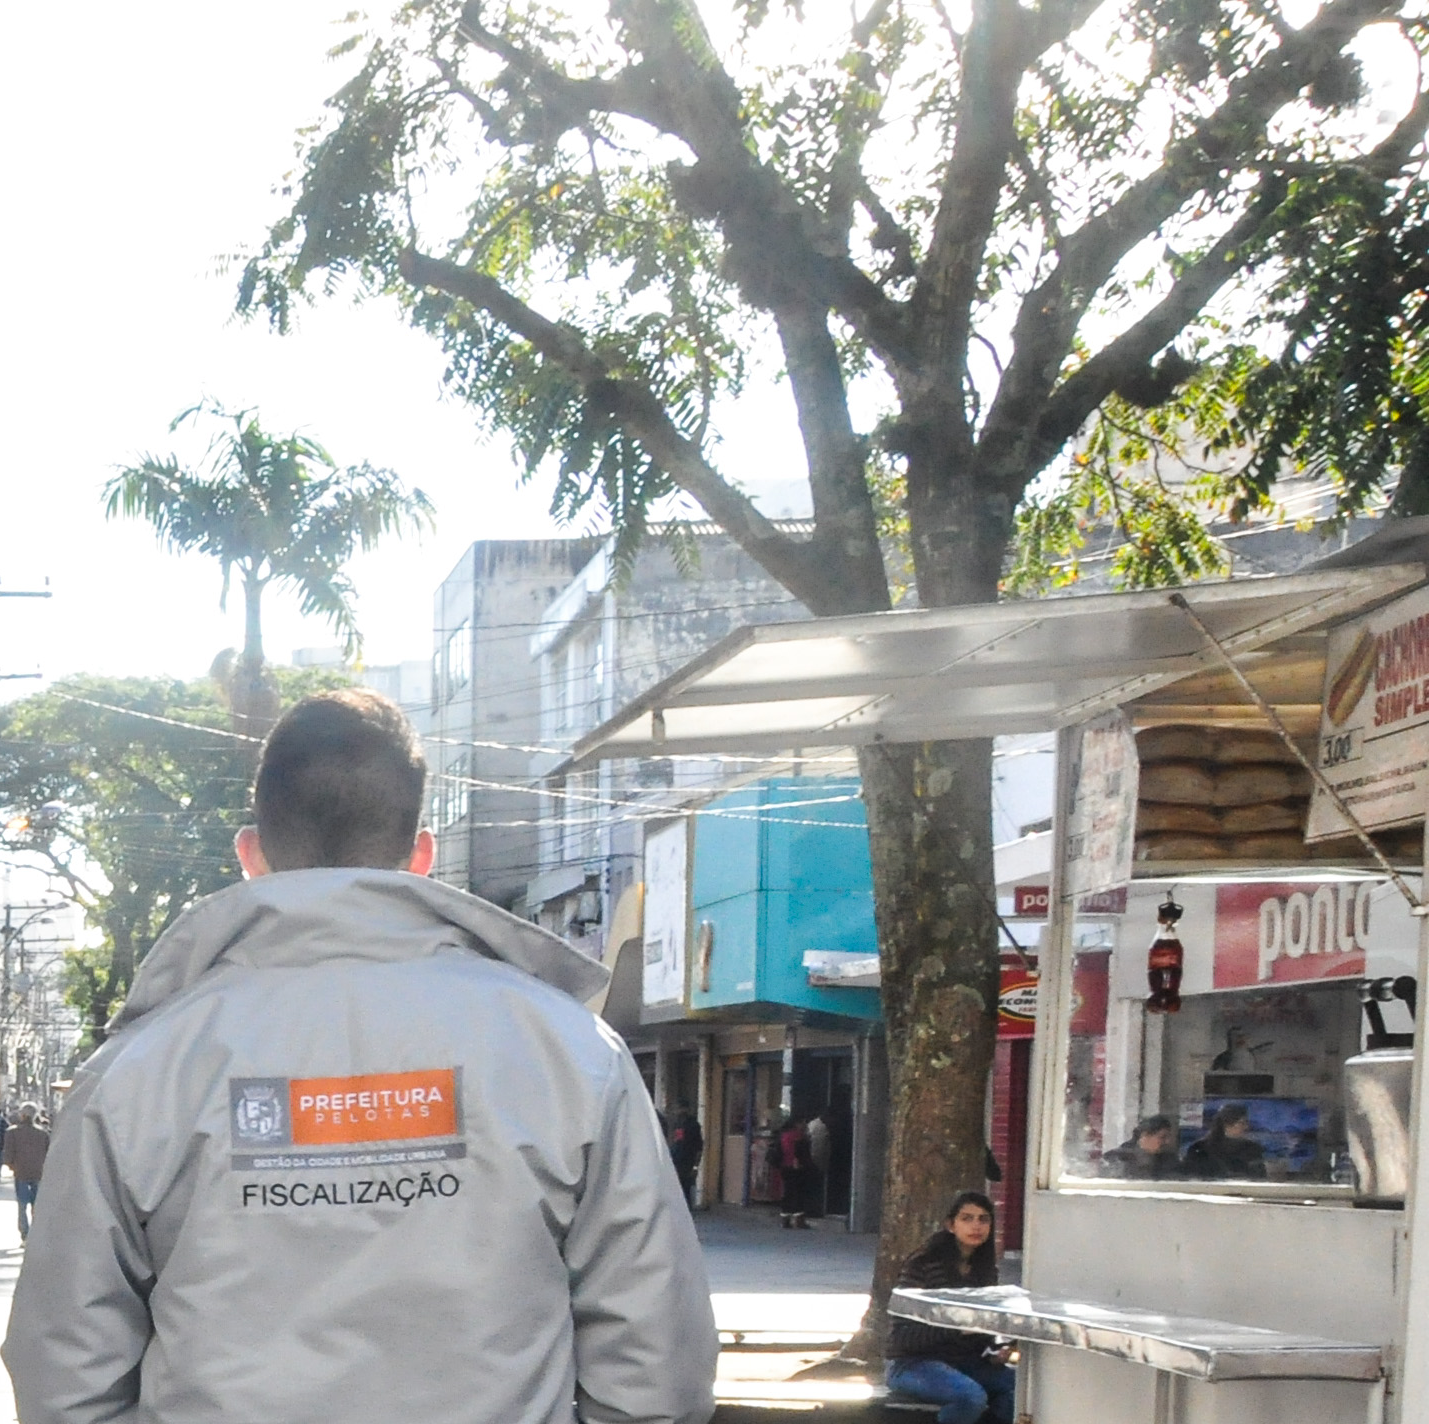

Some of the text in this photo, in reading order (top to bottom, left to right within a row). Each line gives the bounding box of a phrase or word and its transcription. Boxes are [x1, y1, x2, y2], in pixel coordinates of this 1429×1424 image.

[300, 1086, 443, 1112] PREFEITURA
[315, 1107, 431, 1124] PELOTAS
[243, 1172, 460, 1207] FISCALIZAÇÃO
